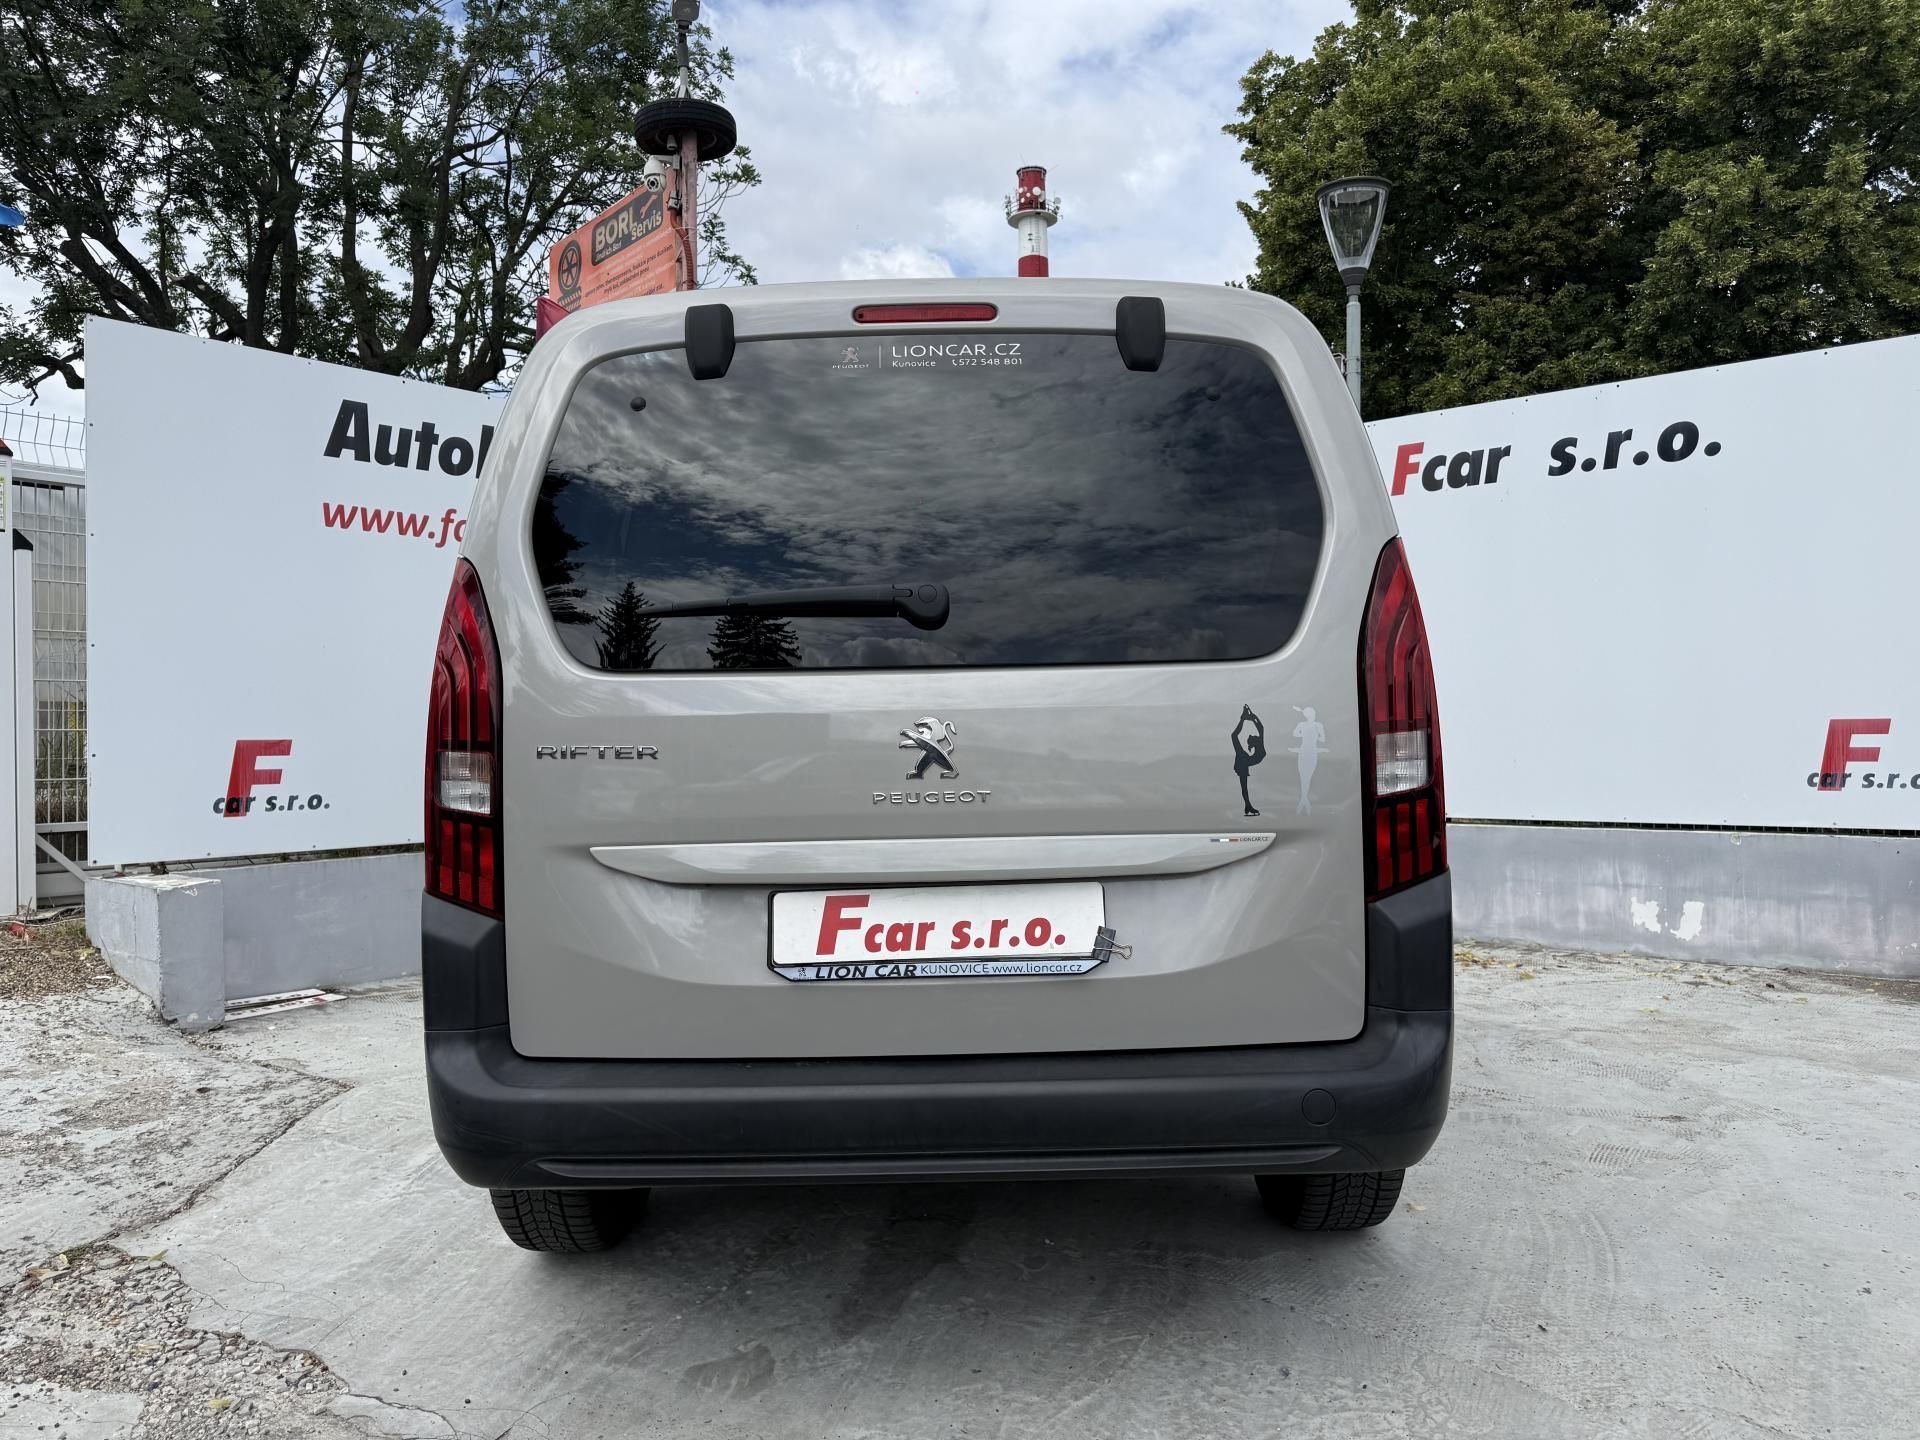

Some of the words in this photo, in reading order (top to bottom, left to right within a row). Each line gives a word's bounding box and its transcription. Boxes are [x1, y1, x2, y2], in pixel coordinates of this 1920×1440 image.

[631, 209, 662, 241] servis
[892, 343, 1021, 358] LIONCAR.CZ
[958, 358, 977, 366] 572
[980, 358, 1000, 366] 548
[1004, 358, 1022, 366] 801
[323, 399, 494, 479] Auto
[1391, 441, 1512, 496] Fcar
[1547, 421, 1722, 477] s.r.o.
[536, 745, 659, 760] RIFTER
[265, 794, 330, 812] s.r.o.
[872, 790, 992, 804] PEUGEOT
[950, 917, 1066, 950] s.r.o.
[815, 965, 868, 979] LION
[874, 964, 918, 977] CAR
[920, 963, 990, 975] KUNOVICE
[991, 961, 1083, 975] www.lioncar.cz
